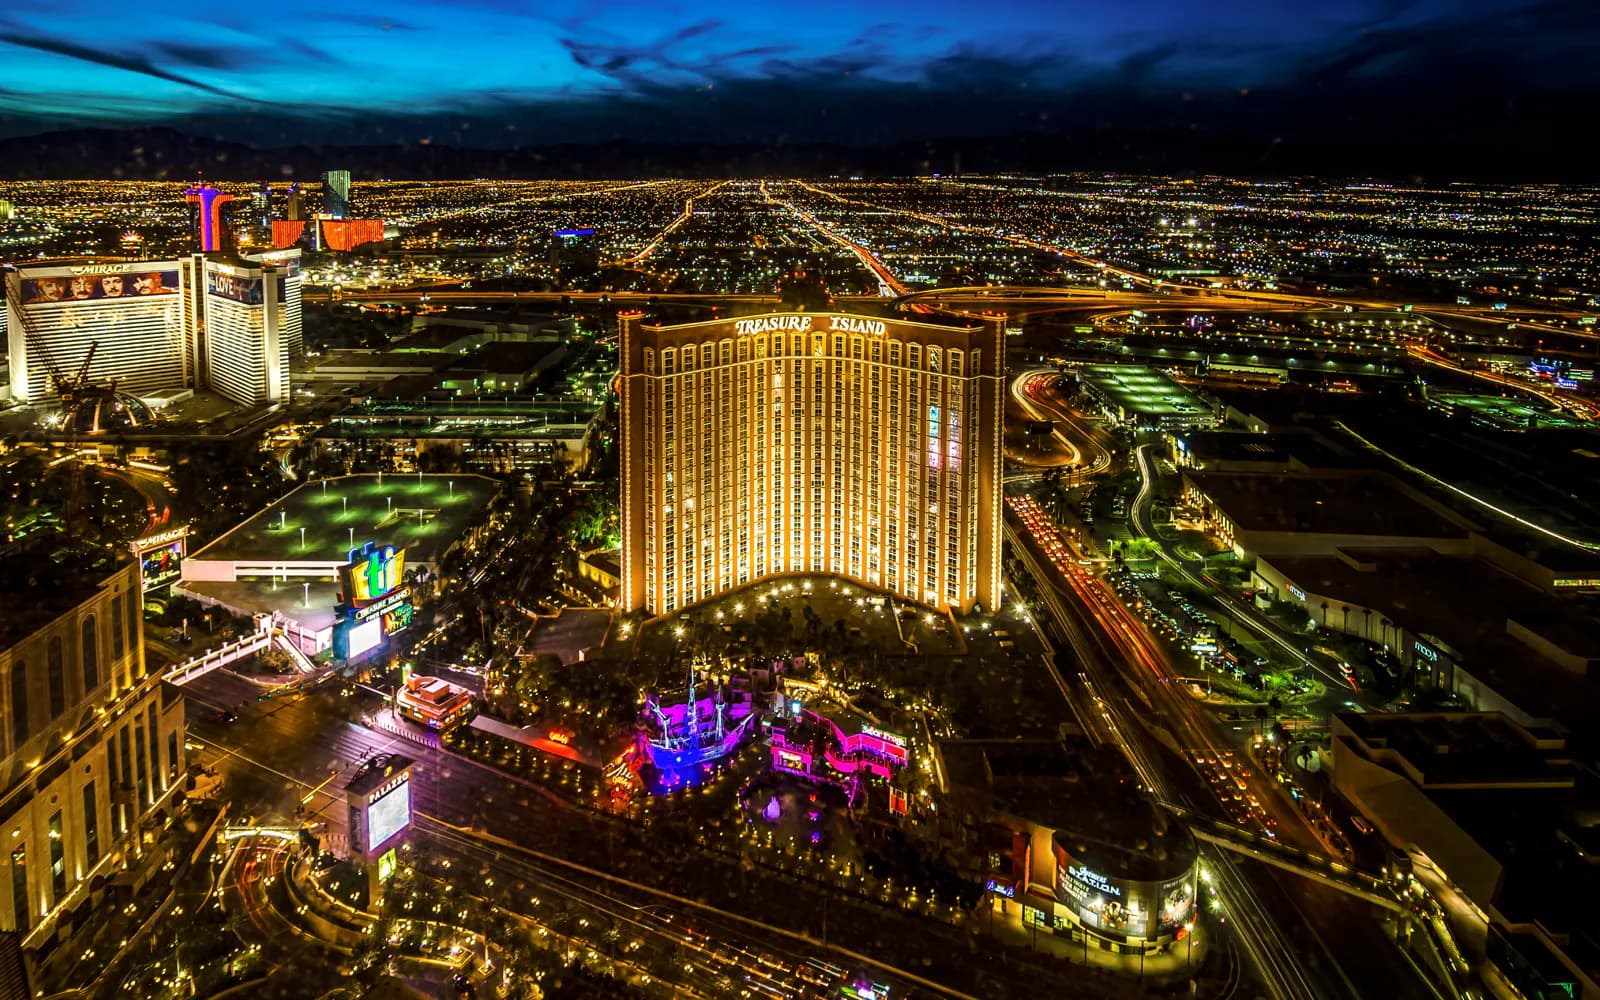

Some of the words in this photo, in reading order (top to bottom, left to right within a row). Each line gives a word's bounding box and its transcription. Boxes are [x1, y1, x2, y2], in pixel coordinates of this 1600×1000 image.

[71, 264, 130, 275] MIRAGE
[215, 273, 234, 295] LOVE
[735, 316, 812, 335] TREASURE
[829, 316, 886, 335] ISLAND
[136, 528, 185, 549] MIRAGE
[368, 771, 410, 804] PALAZZO
